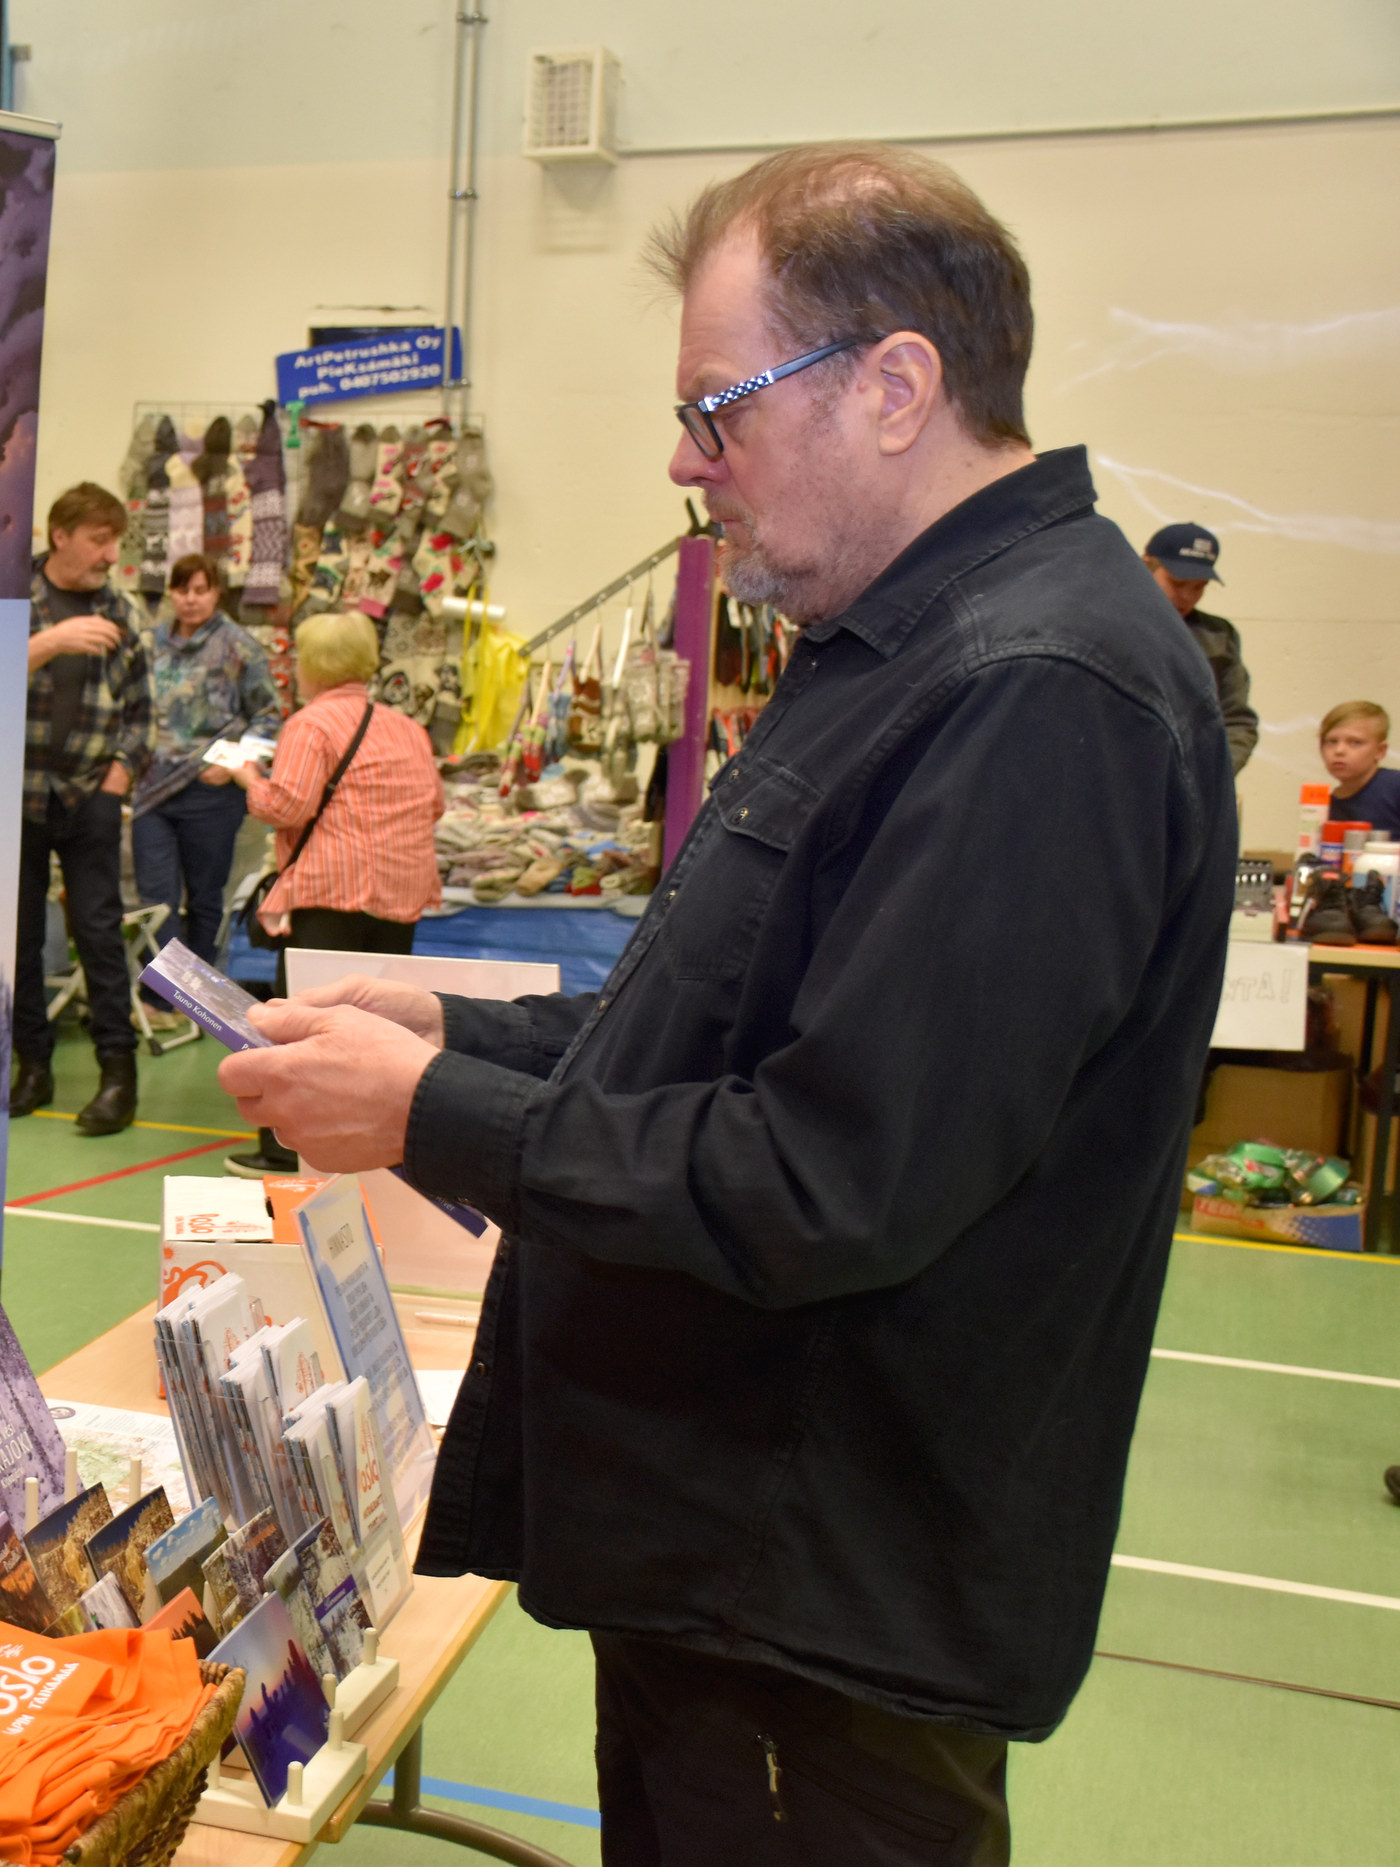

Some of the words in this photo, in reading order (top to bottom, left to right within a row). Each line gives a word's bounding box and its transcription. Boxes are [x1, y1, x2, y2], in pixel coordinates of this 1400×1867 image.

[294, 341, 412, 370] ArtPetrushka
[415, 335, 441, 350] Oy
[298, 381, 336, 400] puh.
[173, 989, 193, 1009] Tauno
[192, 1005, 223, 1032] Kohonen
